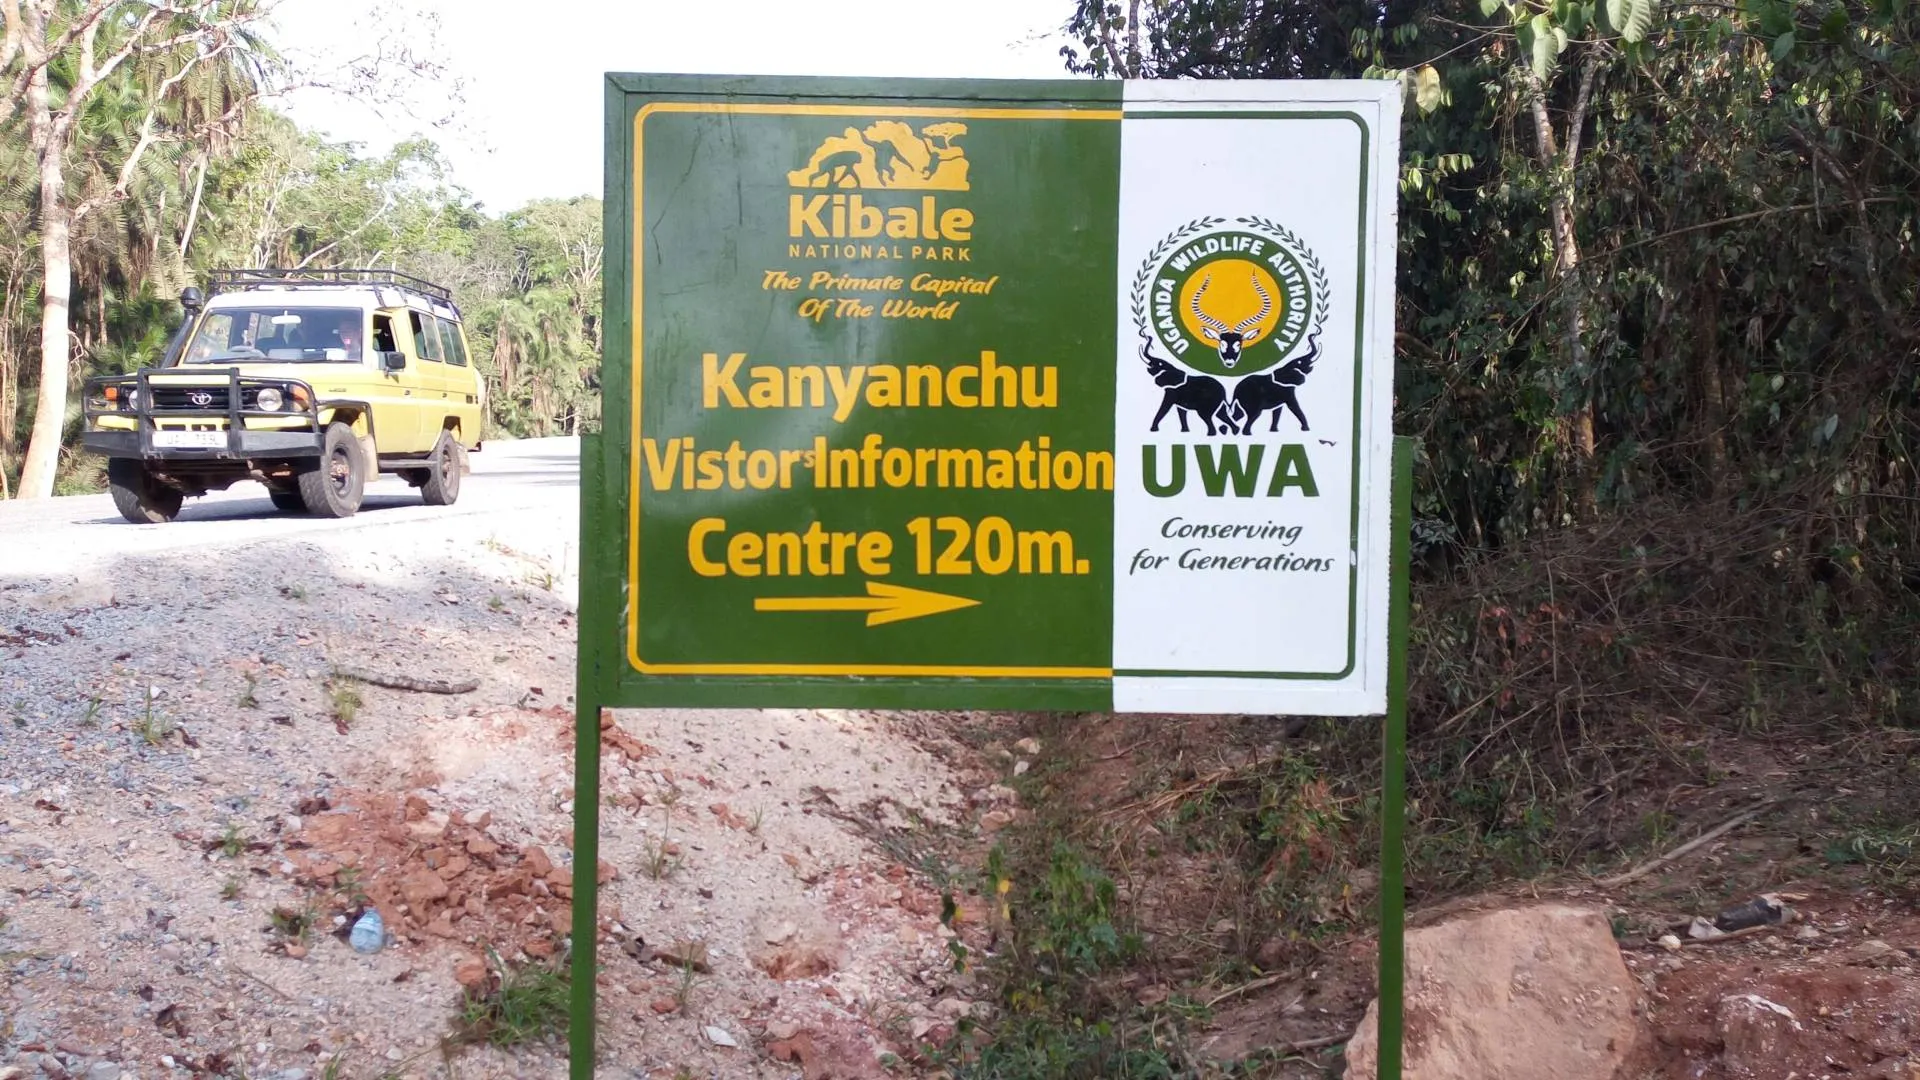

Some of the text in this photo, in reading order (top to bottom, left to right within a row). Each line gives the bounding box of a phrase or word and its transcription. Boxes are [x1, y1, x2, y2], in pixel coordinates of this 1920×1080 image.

[789, 194, 974, 241] Kibale
[788, 244, 971, 261] NATIONAL PARK
[761, 270, 999, 298] The Primate Capital
[1155, 236, 1307, 354] UGANDA WILDLIFE AUTHORITY
[798, 298, 960, 323] Of The World
[702, 350, 1058, 423] Kanyanchu
[814, 433, 1114, 491] Information
[1142, 444, 1320, 498] UWA
[687, 516, 1090, 577] Centre 120m.
[1161, 516, 1303, 547] Conserving
[1129, 548, 1335, 576] for Generations
